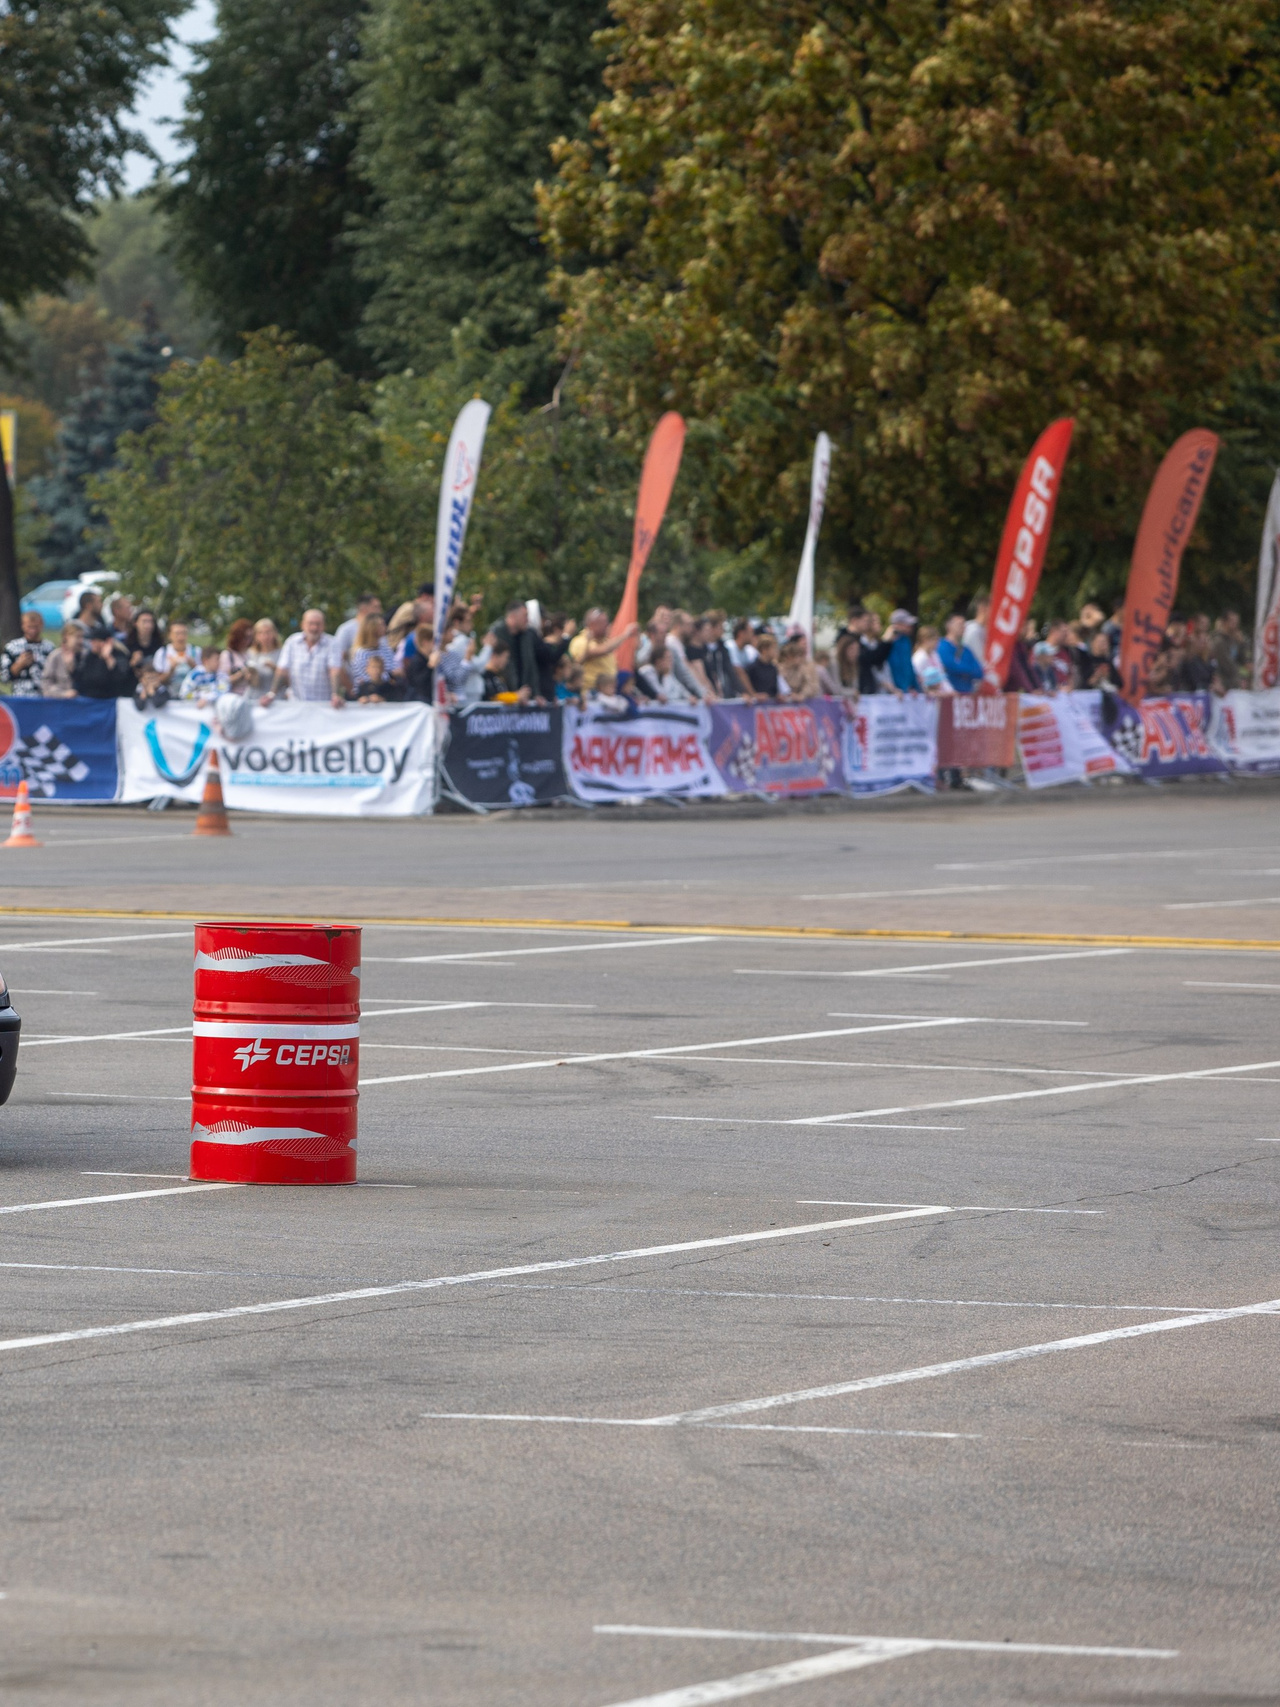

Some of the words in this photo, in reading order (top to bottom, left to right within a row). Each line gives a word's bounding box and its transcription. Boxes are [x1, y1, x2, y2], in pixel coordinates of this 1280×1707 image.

[995, 455, 1056, 635] CEPSA
[1154, 446, 1211, 610] lubricants
[275, 1044, 351, 1066] CEPSA
